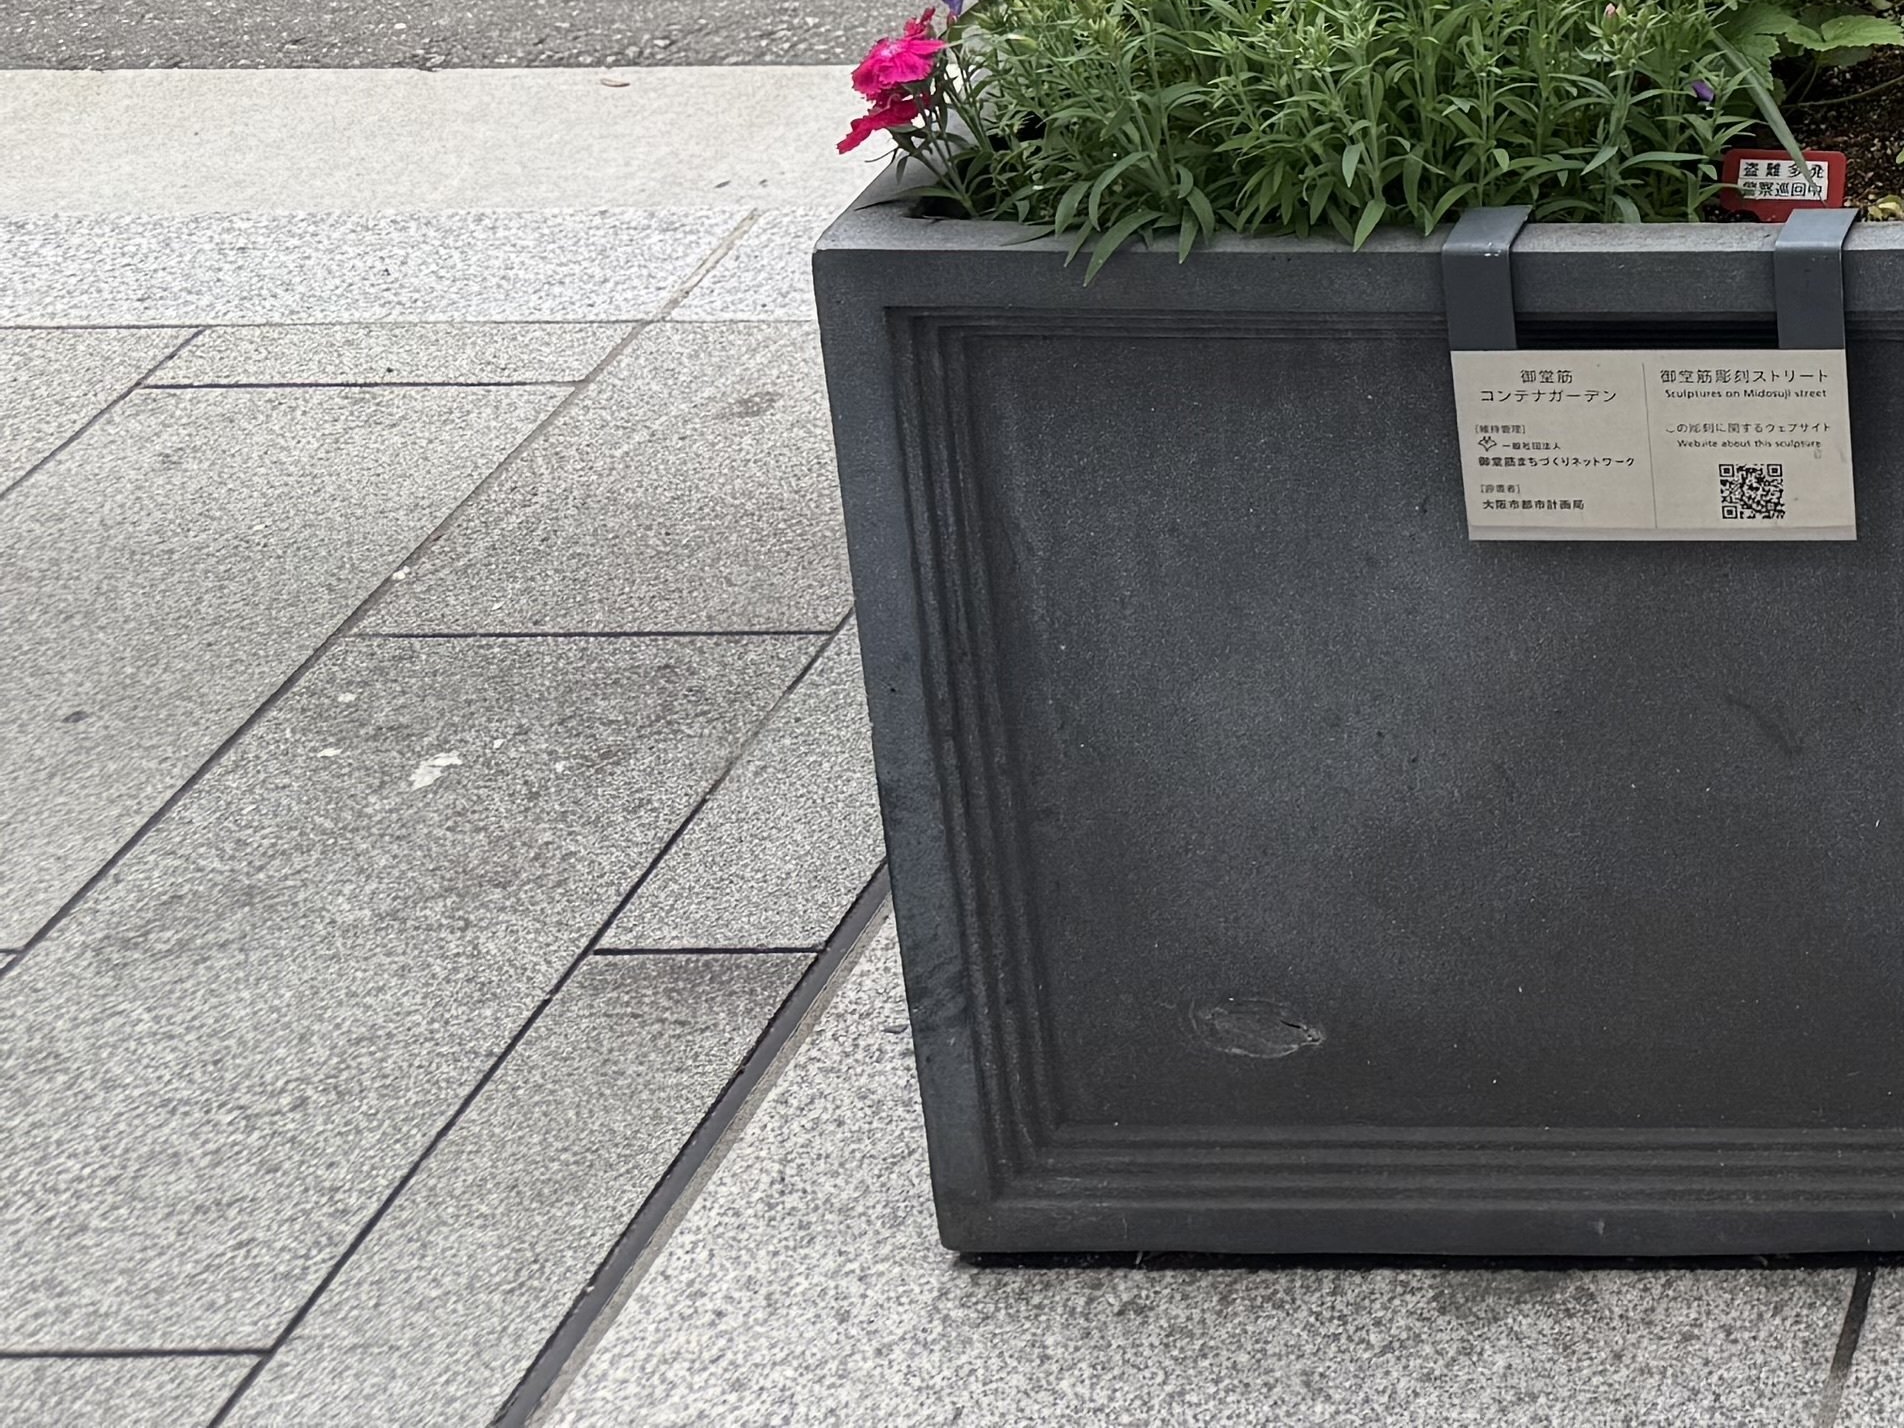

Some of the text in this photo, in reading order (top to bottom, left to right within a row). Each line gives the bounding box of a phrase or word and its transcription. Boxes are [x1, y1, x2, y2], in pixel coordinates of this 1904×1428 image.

[1520, 370, 1574, 384] 御堂筋
[1480, 389, 1617, 403] コンテナガーデン
[1664, 389, 1827, 400] Sculptures on Midosuji street
[1677, 440, 1718, 448] Website
[1721, 440, 1751, 448] about
